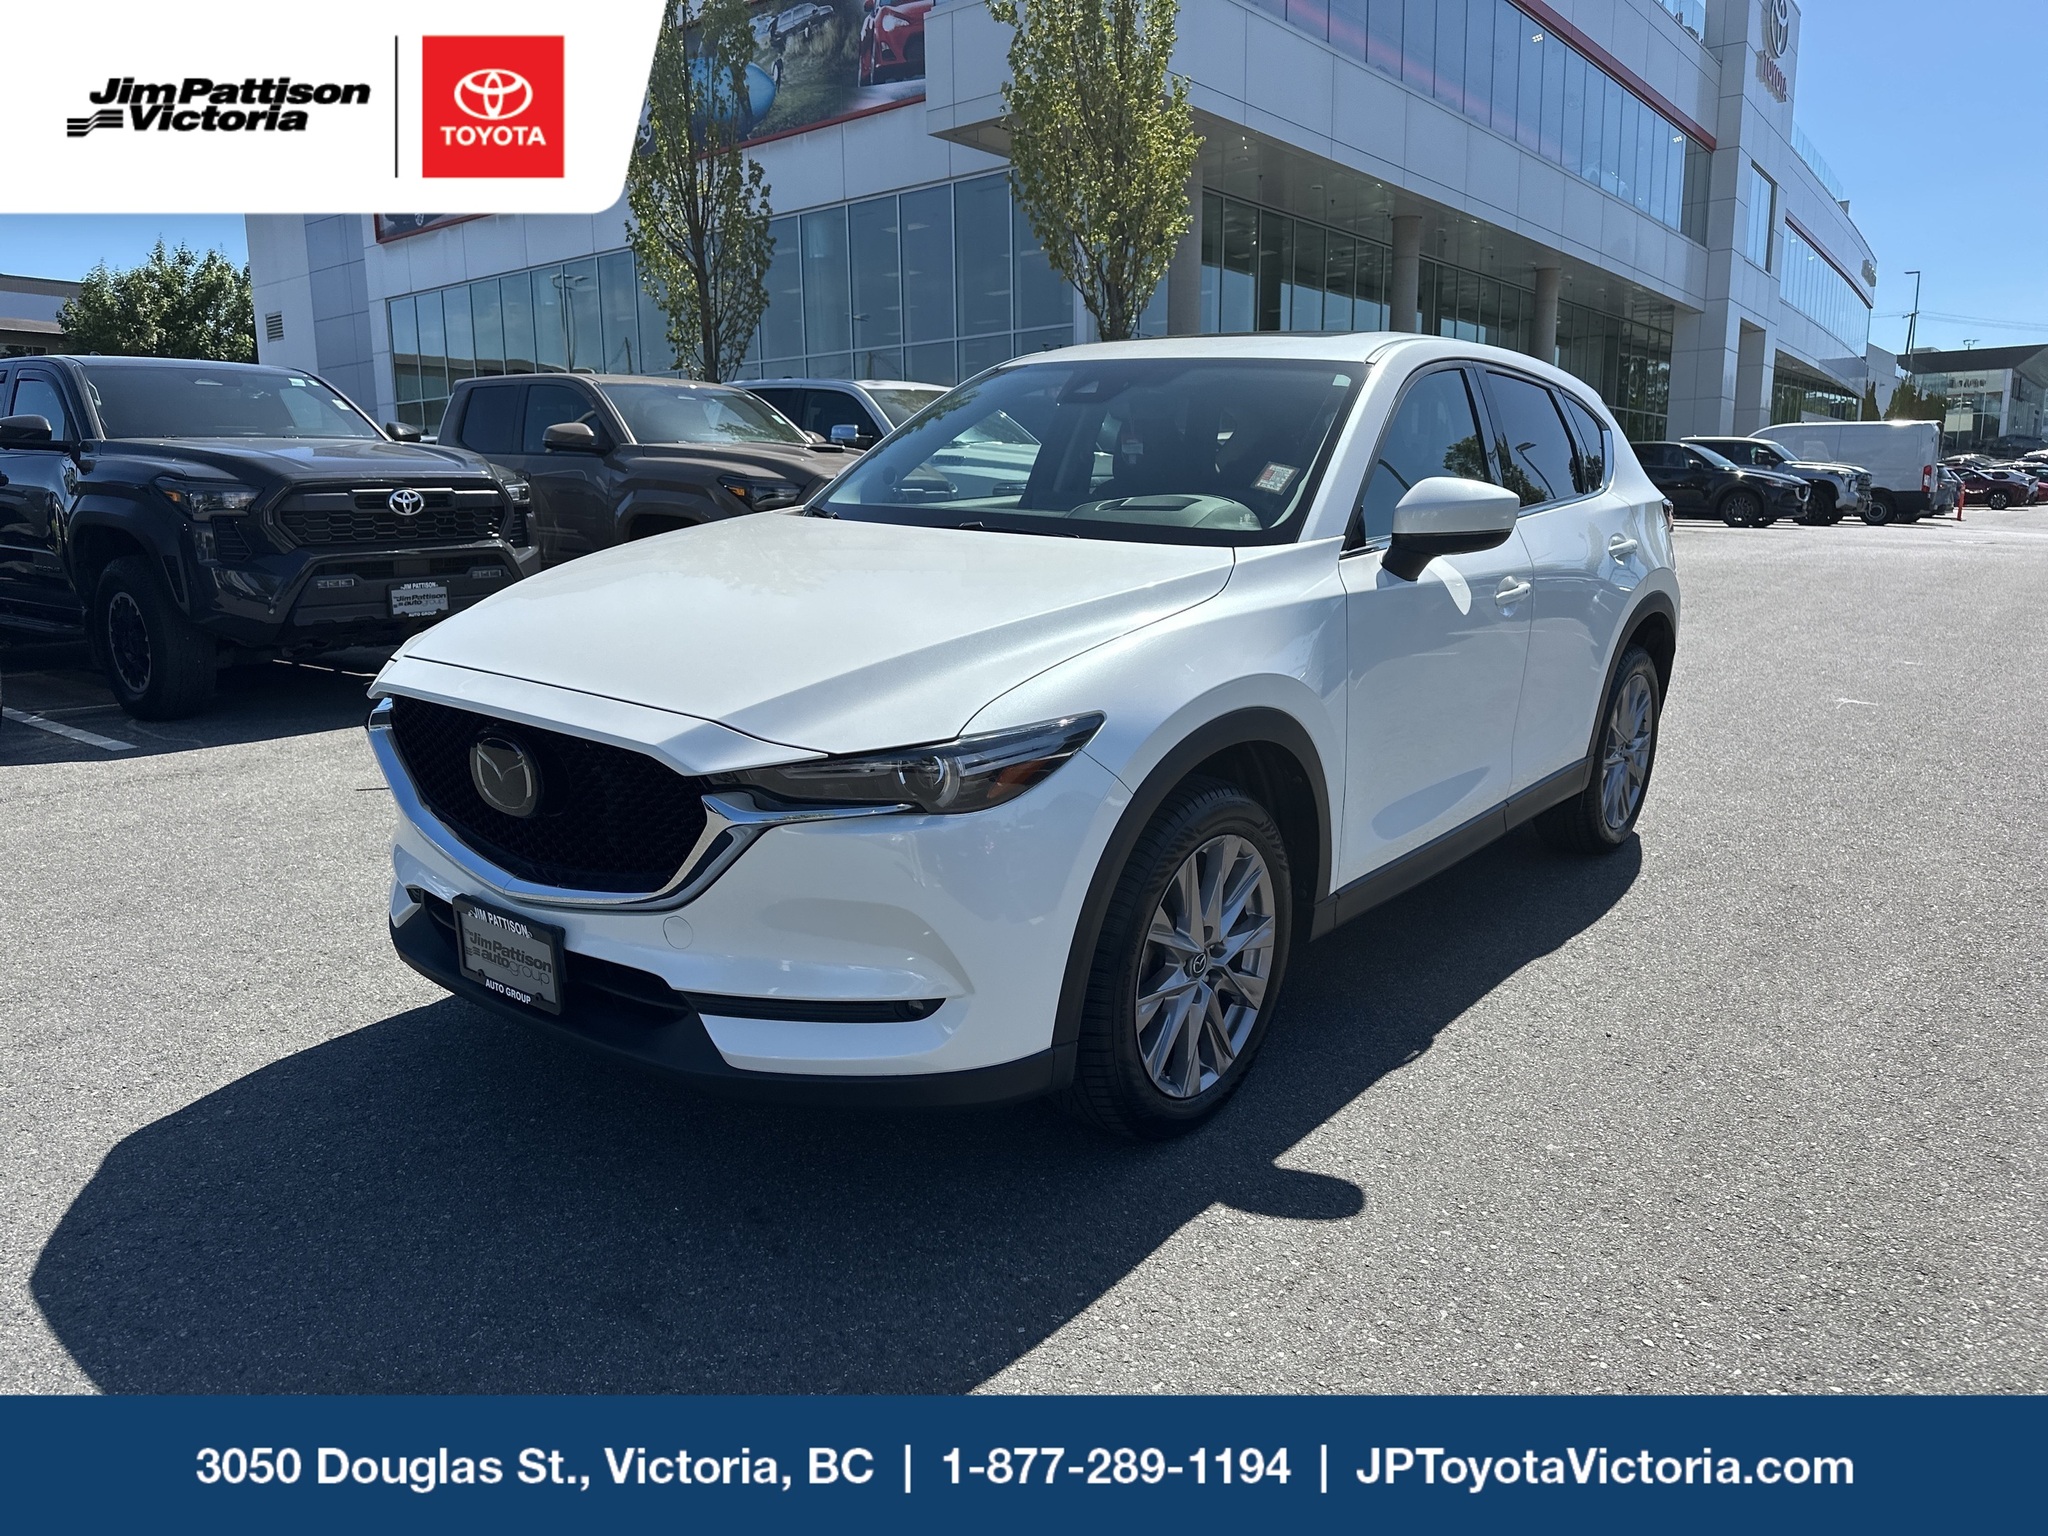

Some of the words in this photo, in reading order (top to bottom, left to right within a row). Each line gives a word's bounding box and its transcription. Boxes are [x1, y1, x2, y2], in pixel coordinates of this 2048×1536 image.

[1760, 50, 1787, 102] TOYOTA
[473, 906, 487, 923] JIM
[488, 911, 528, 938] PATTISON
[485, 978, 504, 994] AUTO
[505, 987, 531, 1004] GROUP
